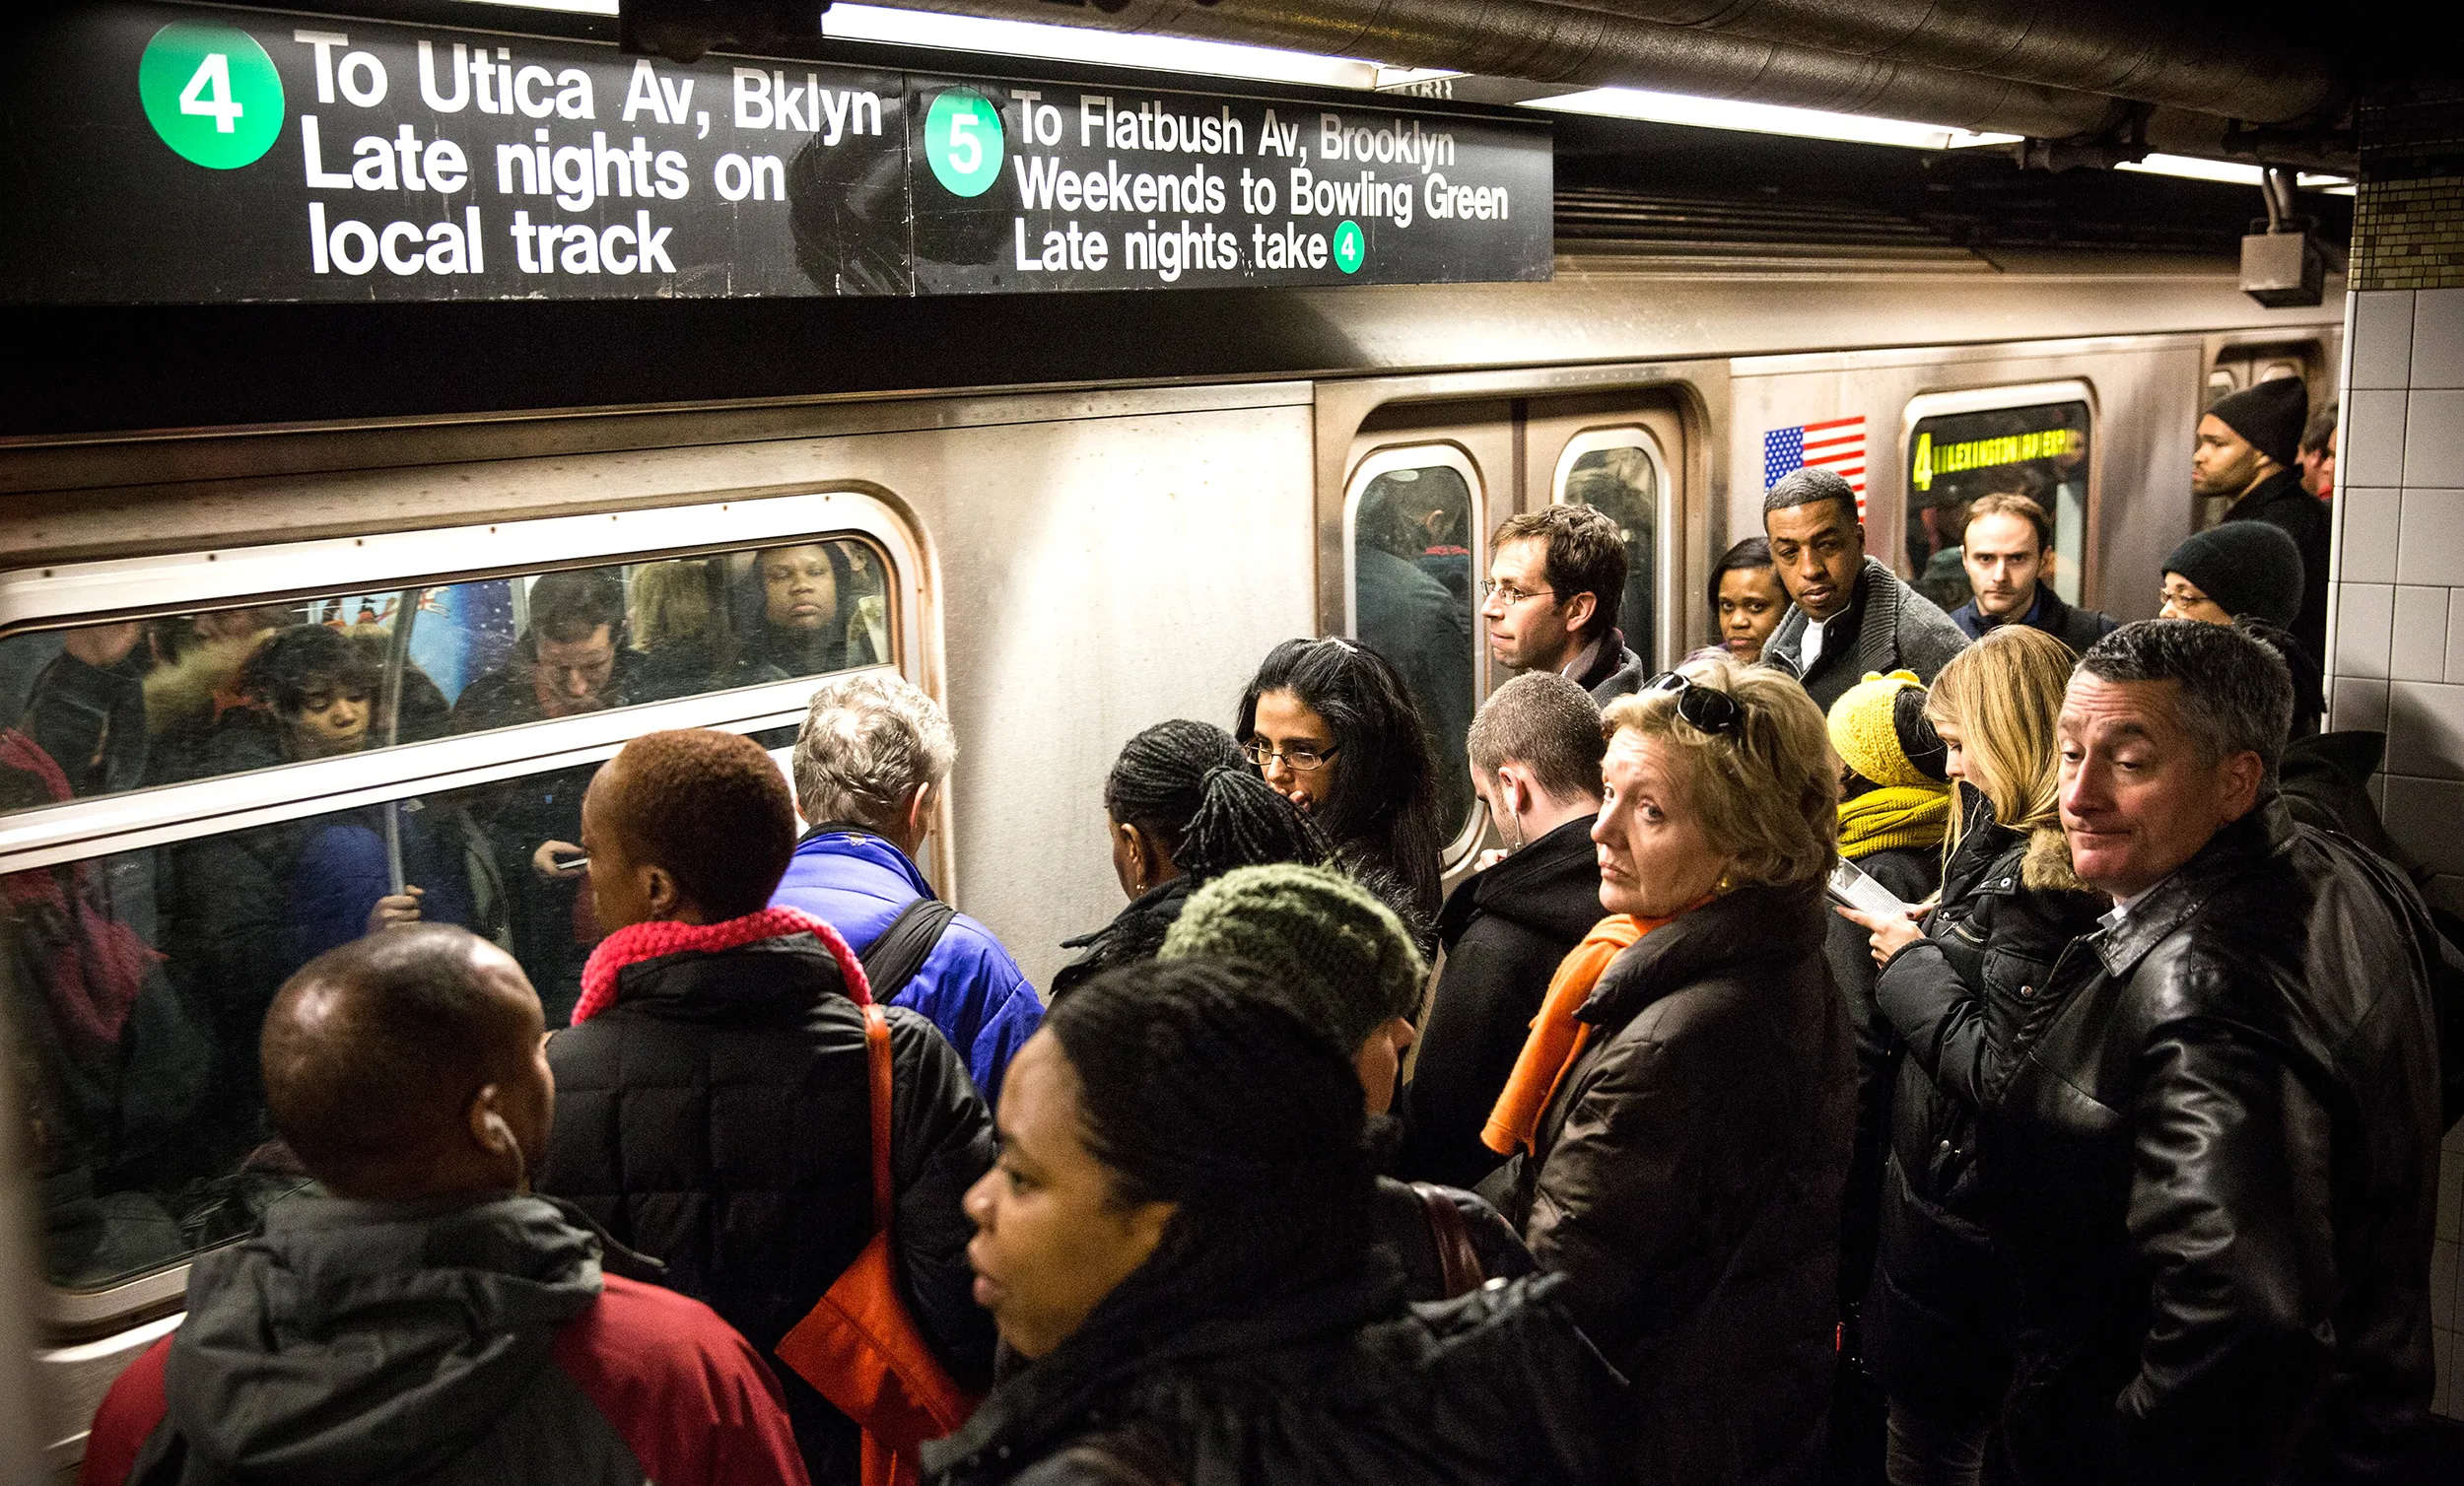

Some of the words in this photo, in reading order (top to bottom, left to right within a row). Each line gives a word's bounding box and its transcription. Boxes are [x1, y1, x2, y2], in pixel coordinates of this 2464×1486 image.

[179, 53, 243, 134] 4
[295, 30, 388, 107] To
[419, 41, 596, 119] Utica
[622, 60, 712, 138] Av,
[733, 68, 882, 146] Bklyn
[303, 115, 467, 192] Late
[497, 129, 689, 211] nights
[715, 154, 786, 201] on
[948, 114, 983, 173] 5
[1010, 90, 1063, 146] To
[1081, 95, 1244, 155] Flatbush
[1259, 108, 1307, 168] Av,
[1321, 113, 1455, 167] Brooklyn
[1013, 156, 1226, 213] Weekends
[1241, 169, 1277, 216] to
[1290, 168, 1413, 229] Bowling
[1422, 173, 1509, 220] Green
[309, 202, 484, 275] local
[511, 210, 677, 275] track
[1015, 218, 1109, 271] Late
[1126, 220, 1238, 282] nights
[1253, 222, 1329, 269] take
[1340, 233, 1356, 261] 4
[1913, 433, 1933, 492] 4
